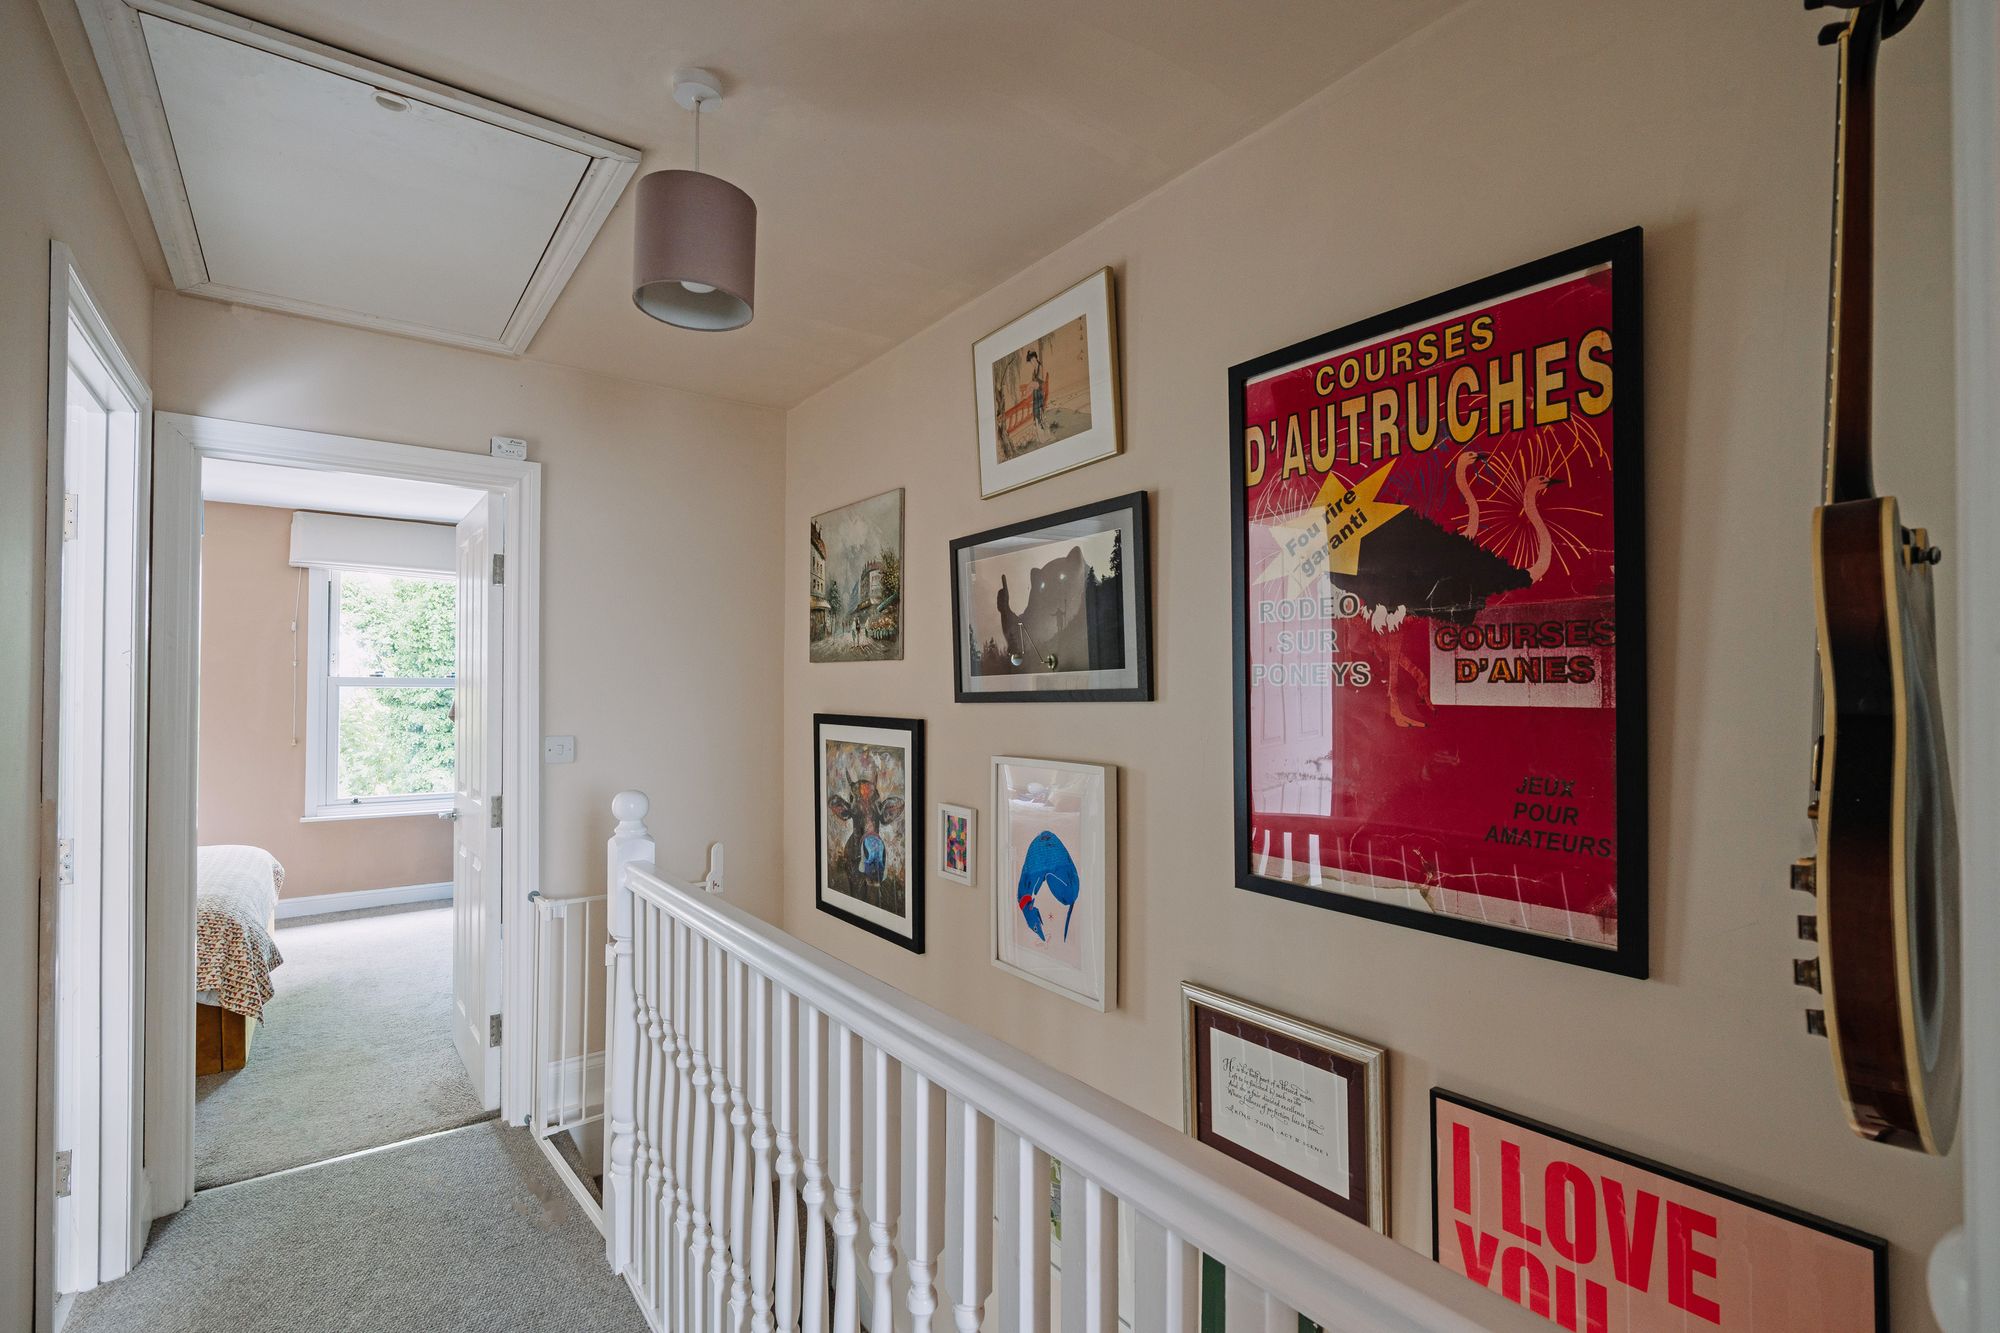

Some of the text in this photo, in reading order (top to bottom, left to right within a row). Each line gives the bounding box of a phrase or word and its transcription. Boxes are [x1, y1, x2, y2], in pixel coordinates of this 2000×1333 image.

[1314, 314, 1496, 396] COURSES
[1245, 327, 1614, 487] D'AUTRUCHES
[1285, 489, 1357, 557] Fou rire
[1301, 507, 1369, 578] garanti
[1258, 592, 1361, 624] RODEO
[1277, 628, 1340, 654] SUR
[1434, 619, 1616, 652] COURSES
[1250, 661, 1371, 687] PONEYS
[1455, 655, 1596, 685] D'ANES
[1515, 776, 1577, 799] JEUX
[1513, 802, 1579, 826] POUR
[1484, 825, 1613, 858] AMATEURS
[1453, 1122, 1720, 1325] I LOVE
